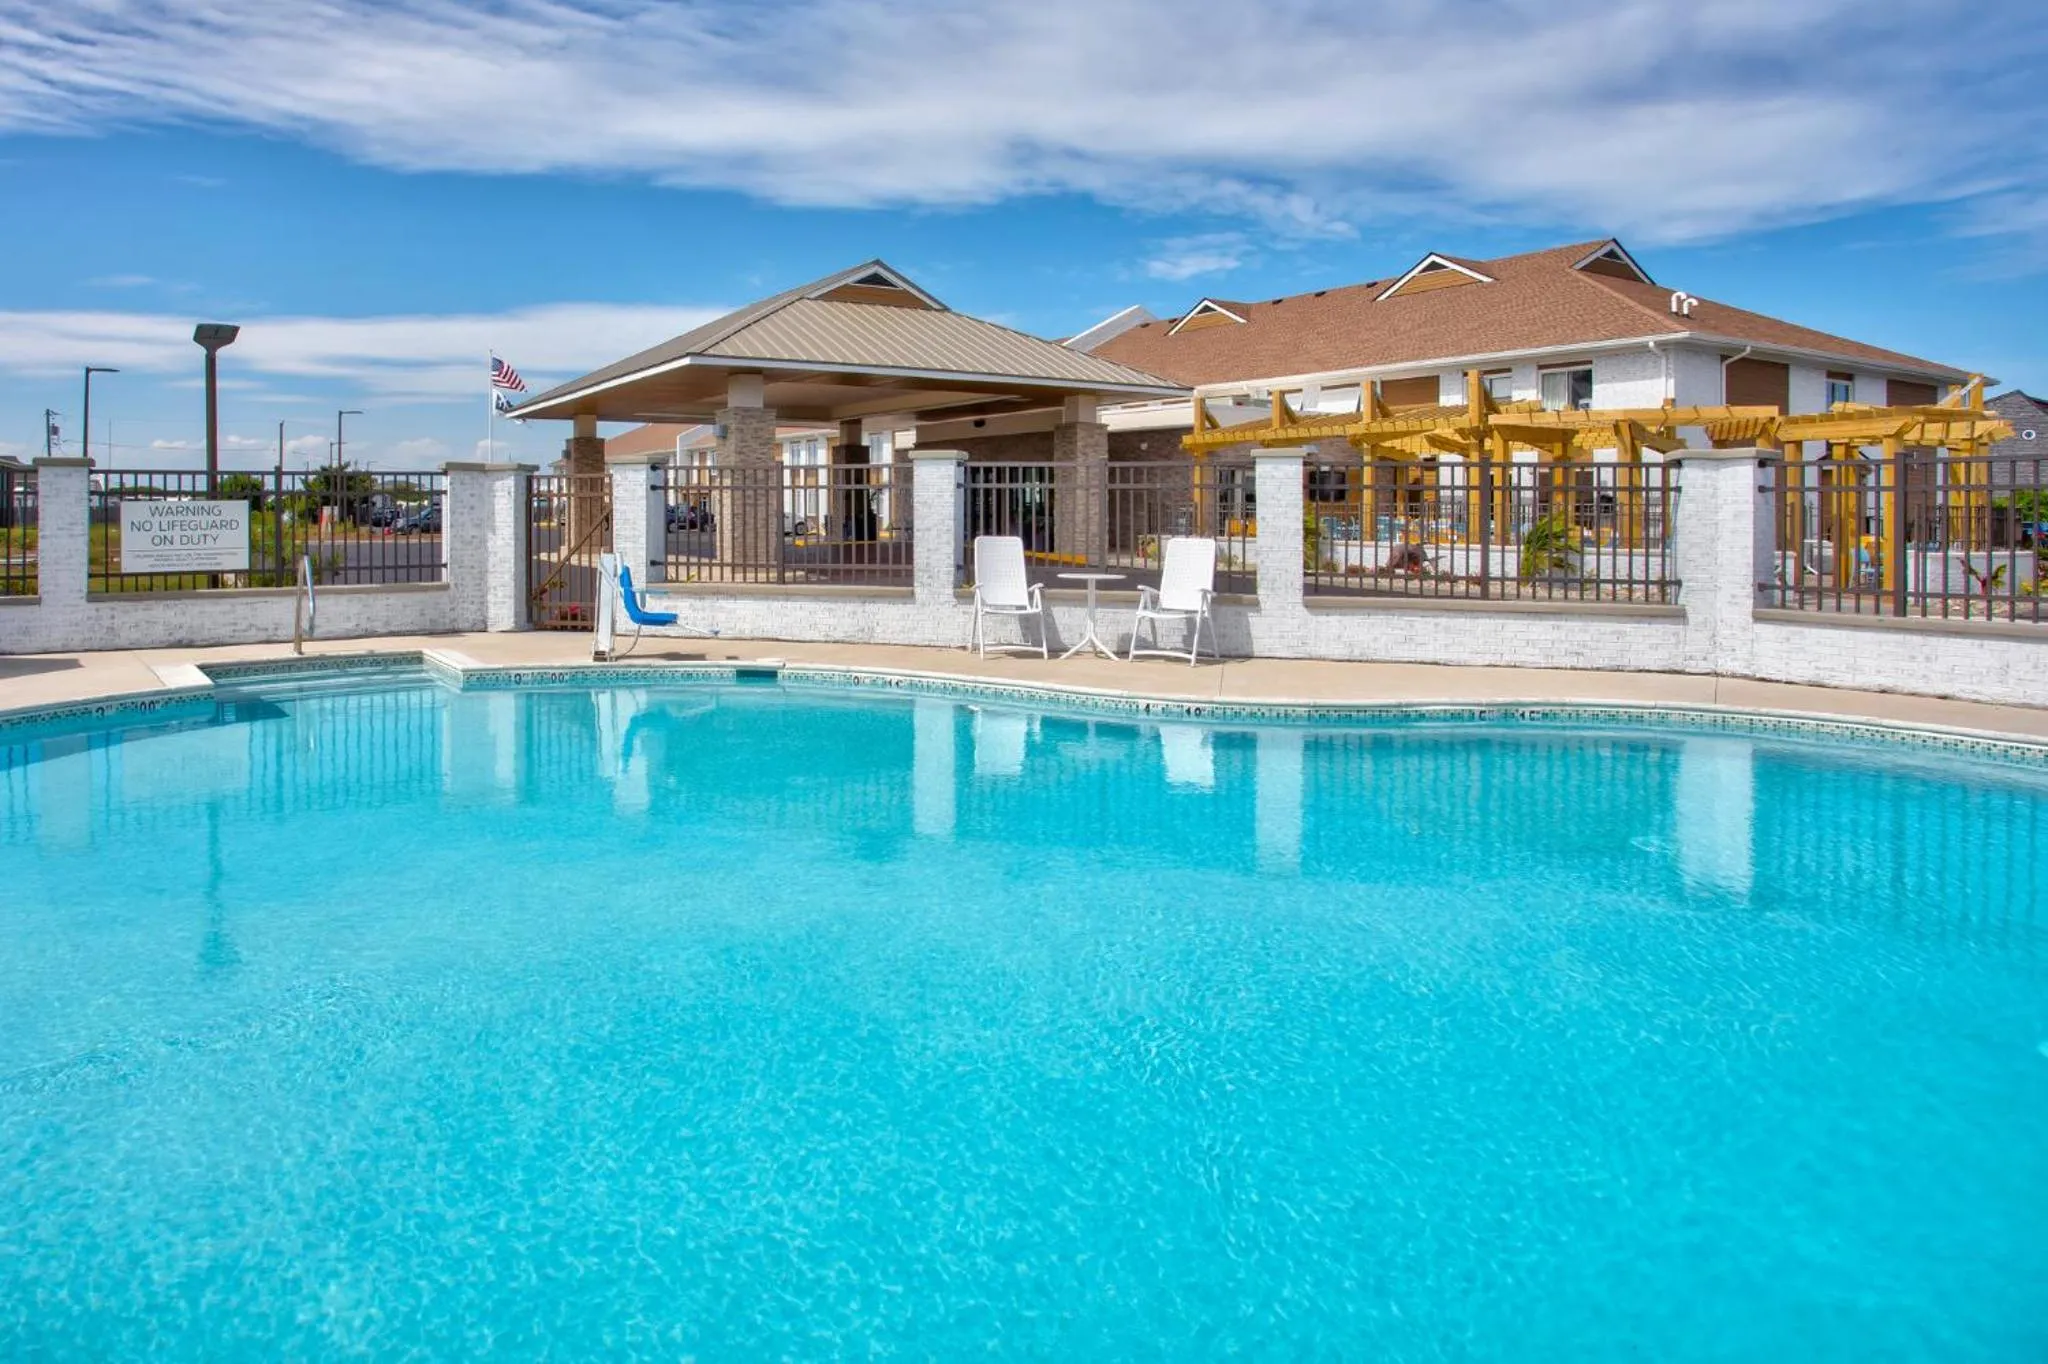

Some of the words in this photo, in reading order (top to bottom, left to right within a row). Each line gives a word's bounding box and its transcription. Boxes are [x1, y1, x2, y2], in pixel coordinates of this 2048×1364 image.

[149, 505, 222, 517] WARNING
[130, 520, 154, 532] NO
[158, 519, 240, 532] LIFEGUARD
[151, 534, 174, 547] ON
[180, 534, 219, 545] DUTY
